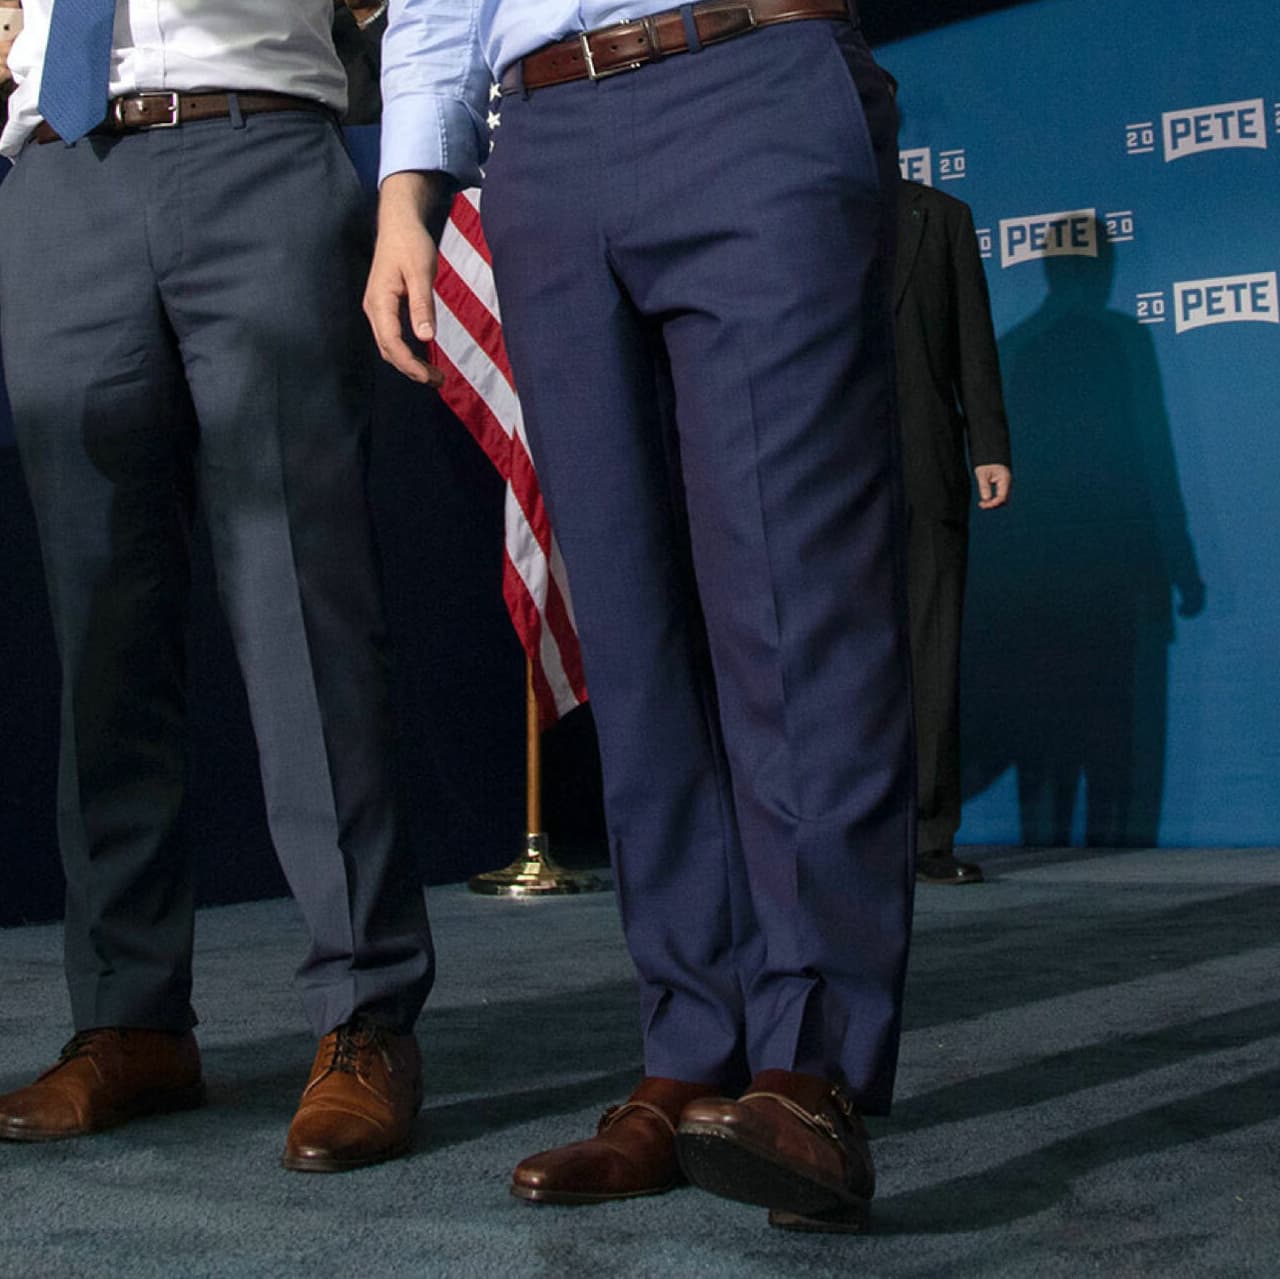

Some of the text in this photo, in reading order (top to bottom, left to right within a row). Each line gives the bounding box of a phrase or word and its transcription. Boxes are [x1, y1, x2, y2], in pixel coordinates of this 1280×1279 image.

[1126, 128, 1154, 148] 20
[1170, 107, 1257, 150] PETE
[939, 157, 966, 174] 20
[1007, 216, 1090, 258] PETE
[1105, 217, 1134, 237] 20
[1137, 298, 1165, 317] 20
[1181, 280, 1271, 322] PETE
